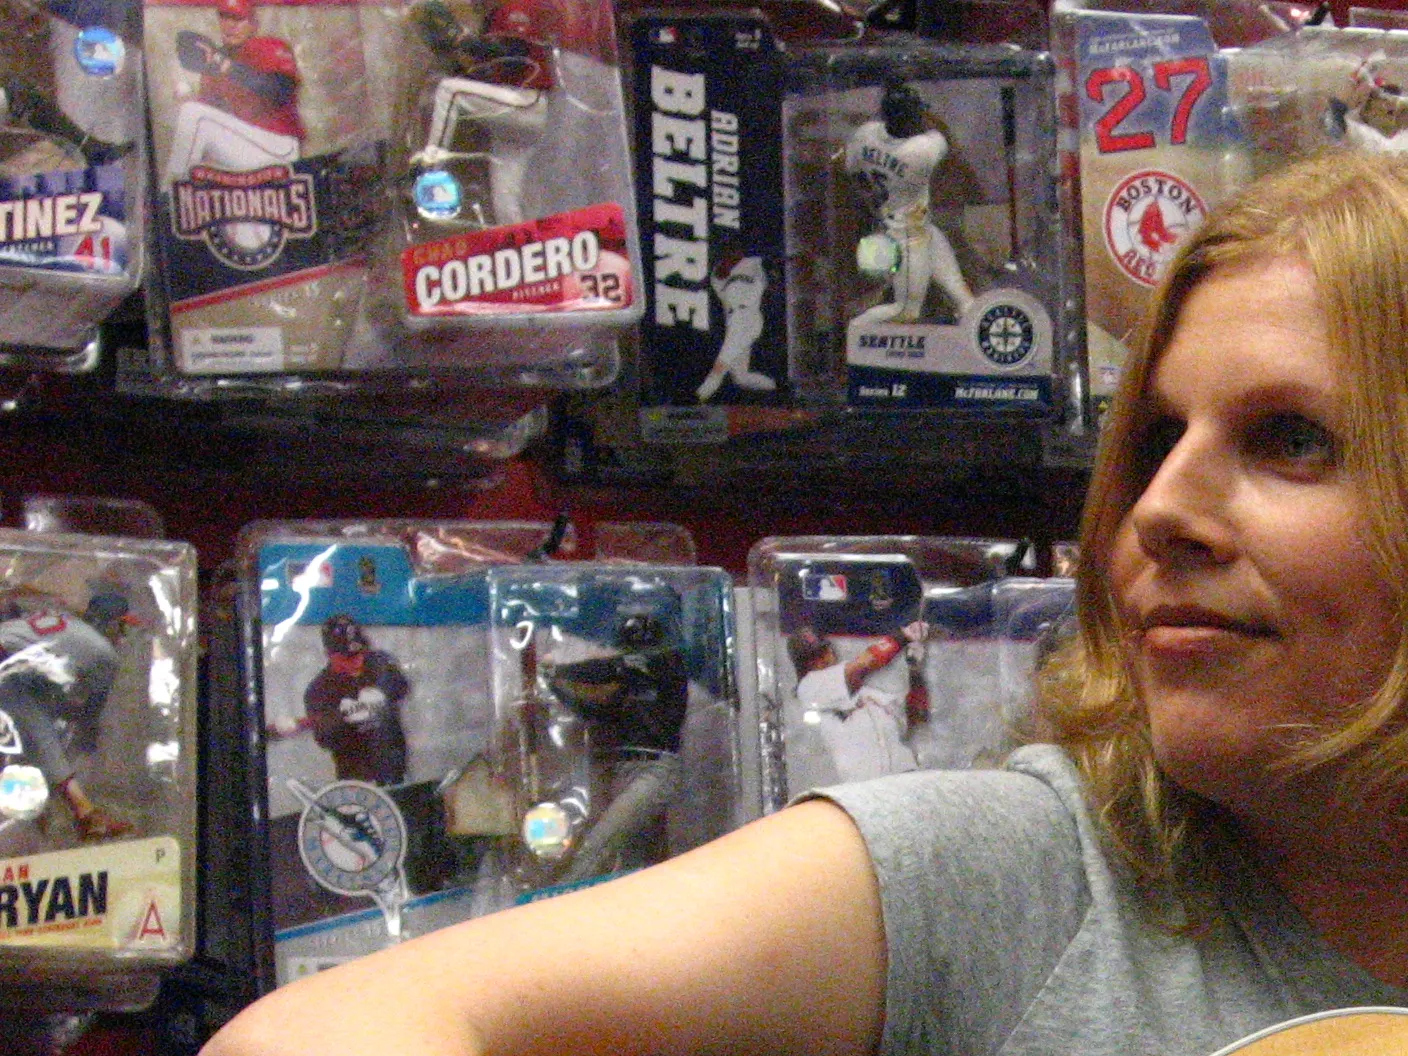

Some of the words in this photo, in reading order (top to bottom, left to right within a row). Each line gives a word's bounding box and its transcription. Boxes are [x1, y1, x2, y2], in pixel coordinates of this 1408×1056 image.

[1086, 57, 1212, 153] 27
[711, 109, 741, 230] ADRIAN
[0, 191, 104, 241] TINEZ
[178, 182, 309, 231] NATIONALS
[651, 64, 713, 332] BELTRE
[1115, 178, 1198, 215] BOSTON
[74, 234, 111, 271] 41
[415, 230, 600, 309] CORDERO
[579, 272, 622, 302] 32
[857, 335, 926, 349] SEATTLE
[156, 848, 166, 863] P
[0, 871, 109, 928] RYAN
